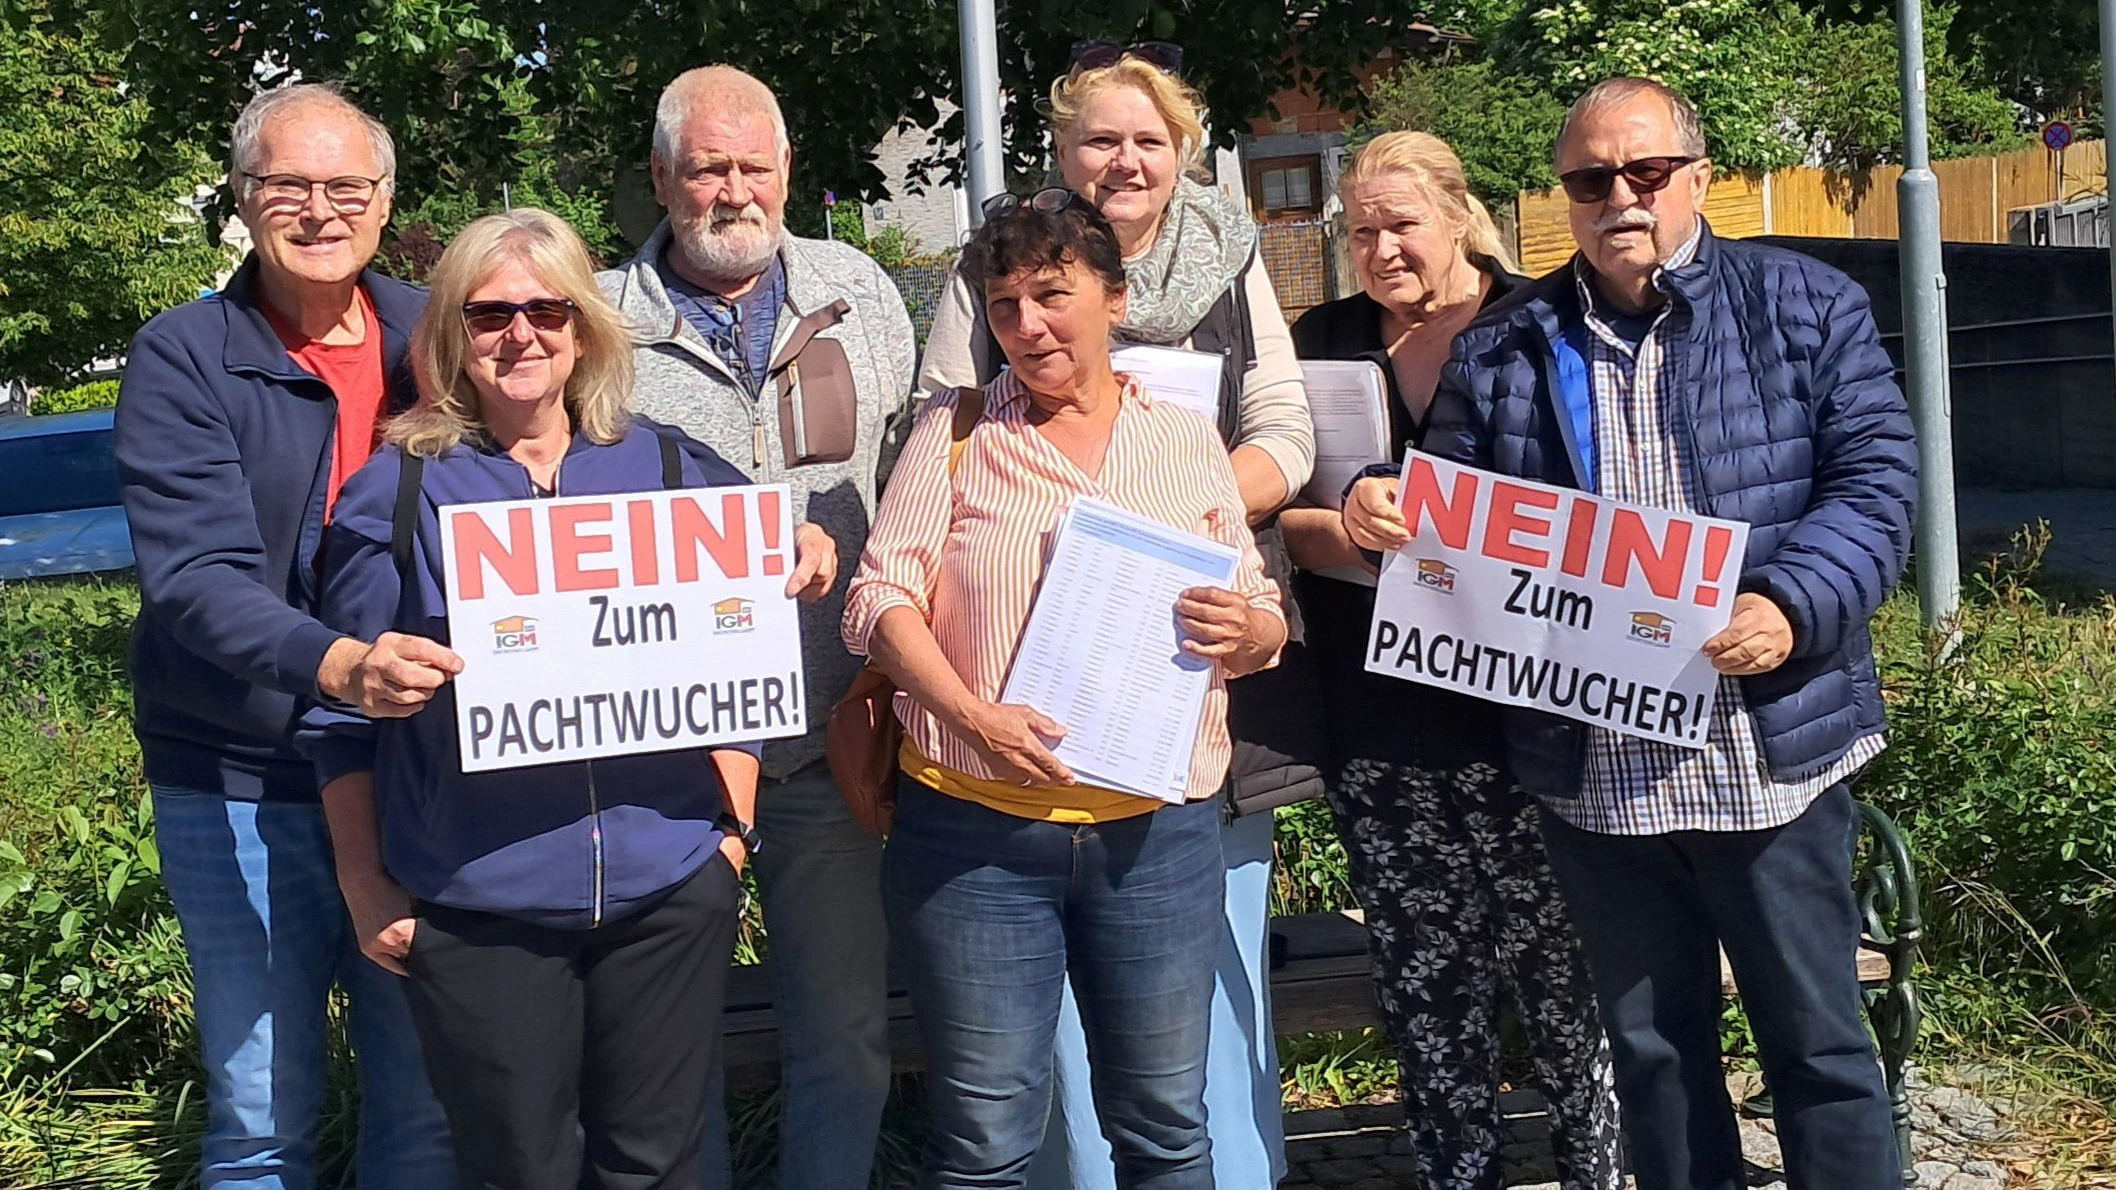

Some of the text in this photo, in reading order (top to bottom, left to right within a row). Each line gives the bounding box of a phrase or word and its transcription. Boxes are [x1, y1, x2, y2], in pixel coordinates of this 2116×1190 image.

[451, 491, 785, 601] NEIN!
[1401, 456, 1733, 608] NEIN!
[1418, 571, 1454, 590] IGM
[1503, 568, 1594, 630] Zum
[495, 632, 537, 649] IGM
[589, 595, 678, 647] Zum
[715, 613, 753, 629] IGM
[1631, 624, 1671, 643] IGM
[1372, 620, 1706, 741] PACHTWUCHER!
[468, 671, 800, 761] PACHTWUCHER!
